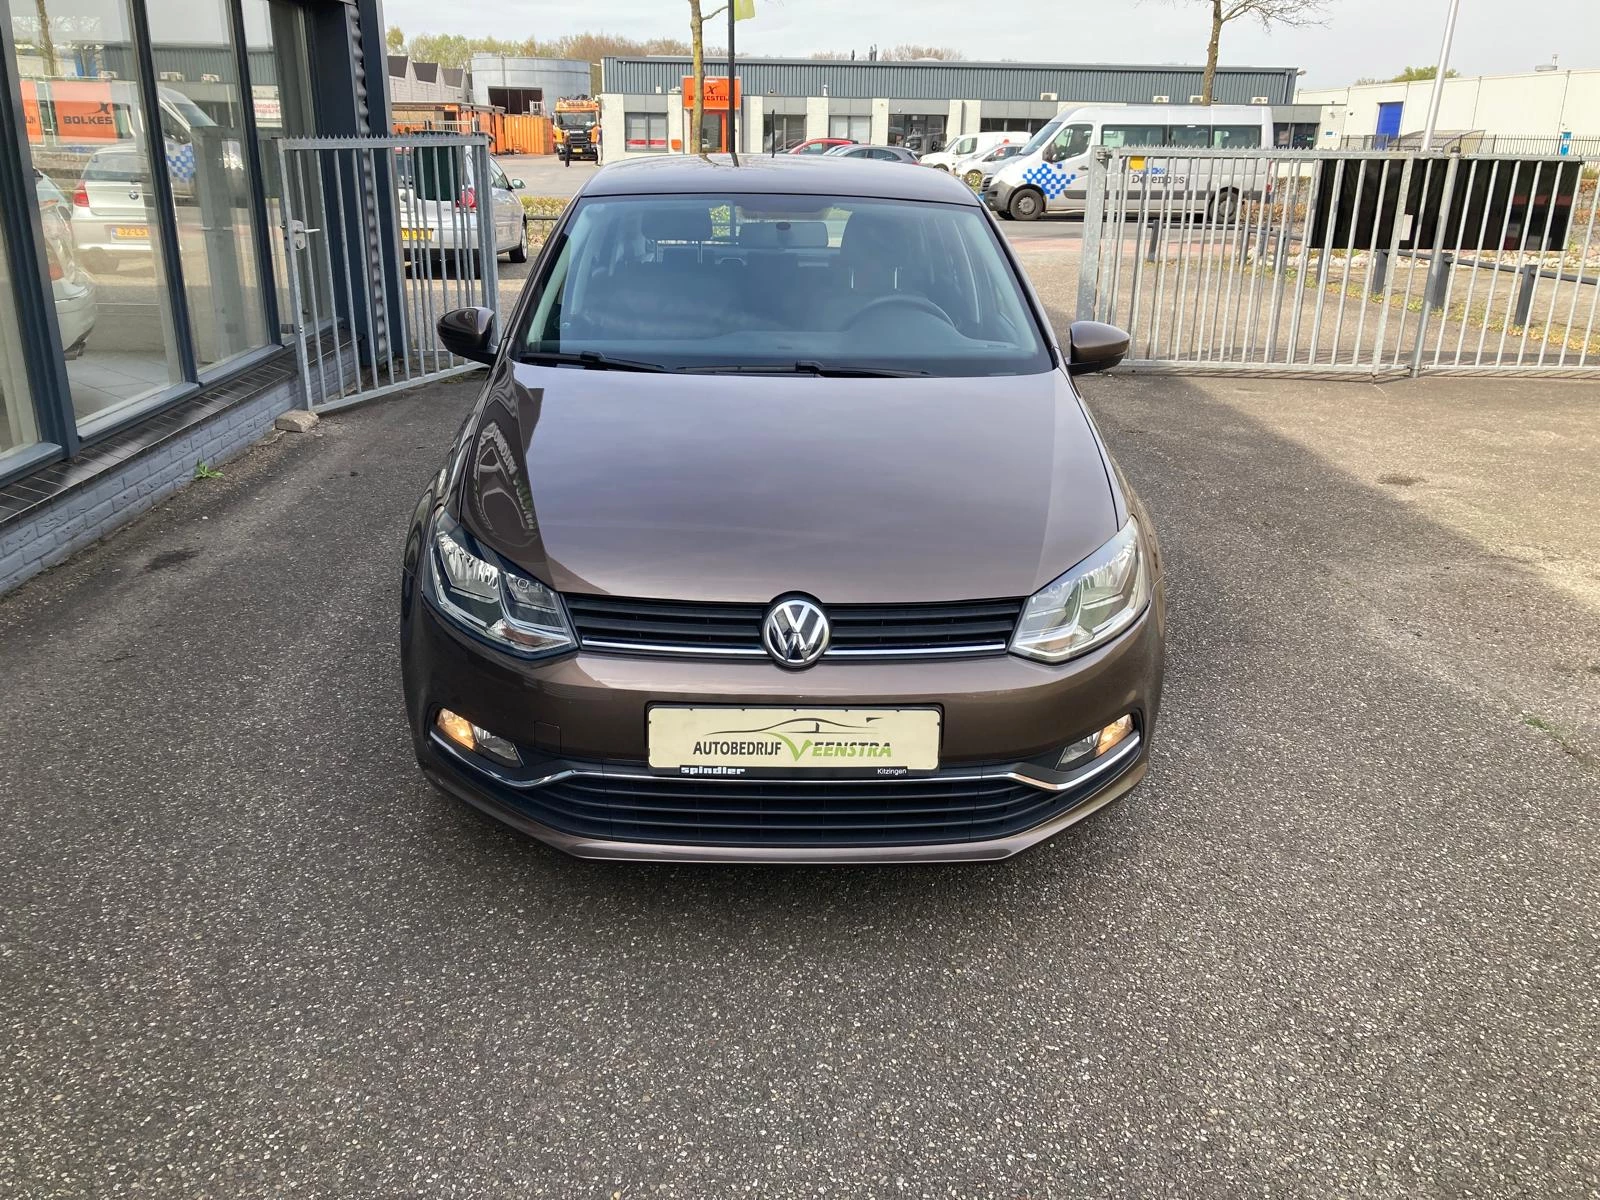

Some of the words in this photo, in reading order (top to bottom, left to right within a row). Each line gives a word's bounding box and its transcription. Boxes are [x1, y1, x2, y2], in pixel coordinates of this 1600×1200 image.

[692, 741, 782, 756] AUTOBEDRIJF
[776, 735, 892, 762] VEENSTRA
[680, 765, 745, 776] spindler
[877, 767, 907, 776] Kitzingen
